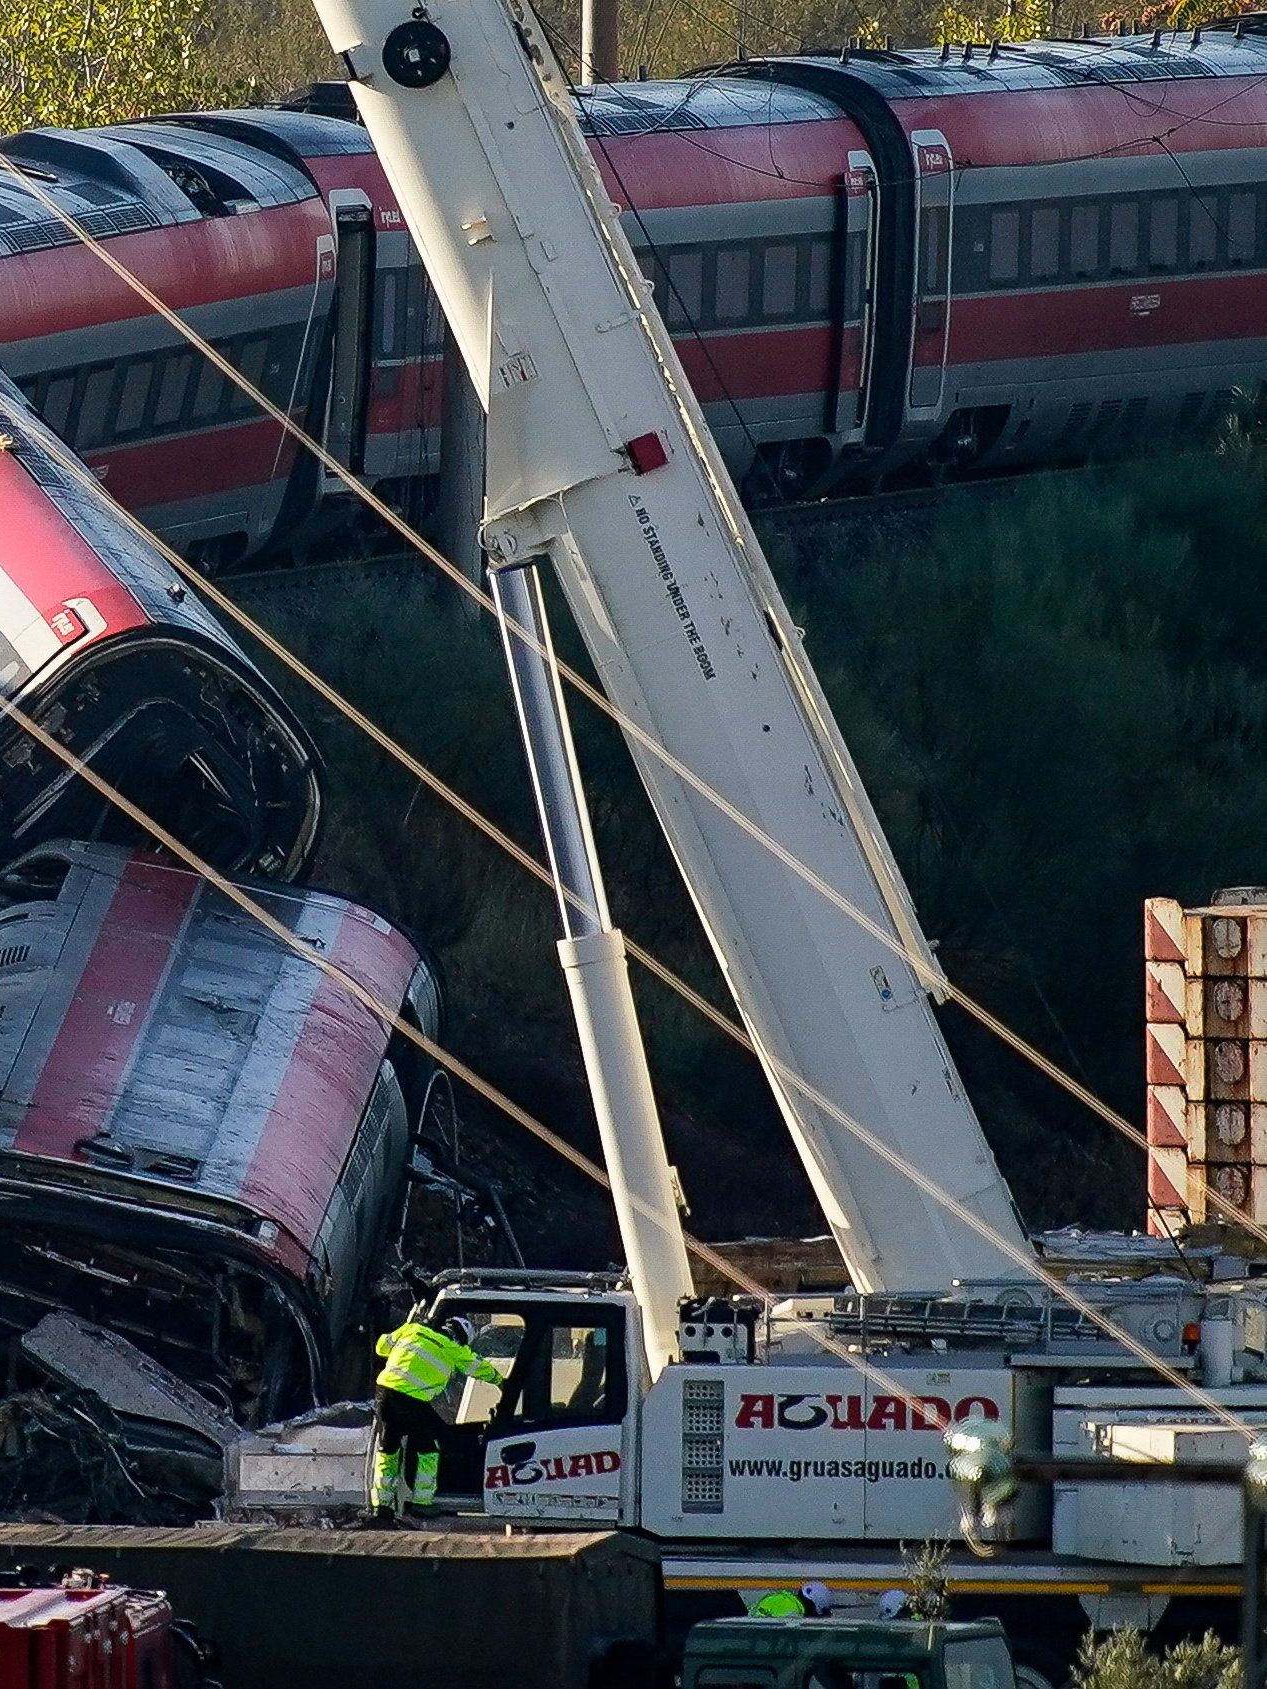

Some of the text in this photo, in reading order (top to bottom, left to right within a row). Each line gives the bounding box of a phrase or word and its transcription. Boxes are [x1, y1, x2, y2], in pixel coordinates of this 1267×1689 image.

[635, 507, 717, 681] NO STANDING UNDER THE BOOM
[735, 1394, 999, 1430] AGUADO
